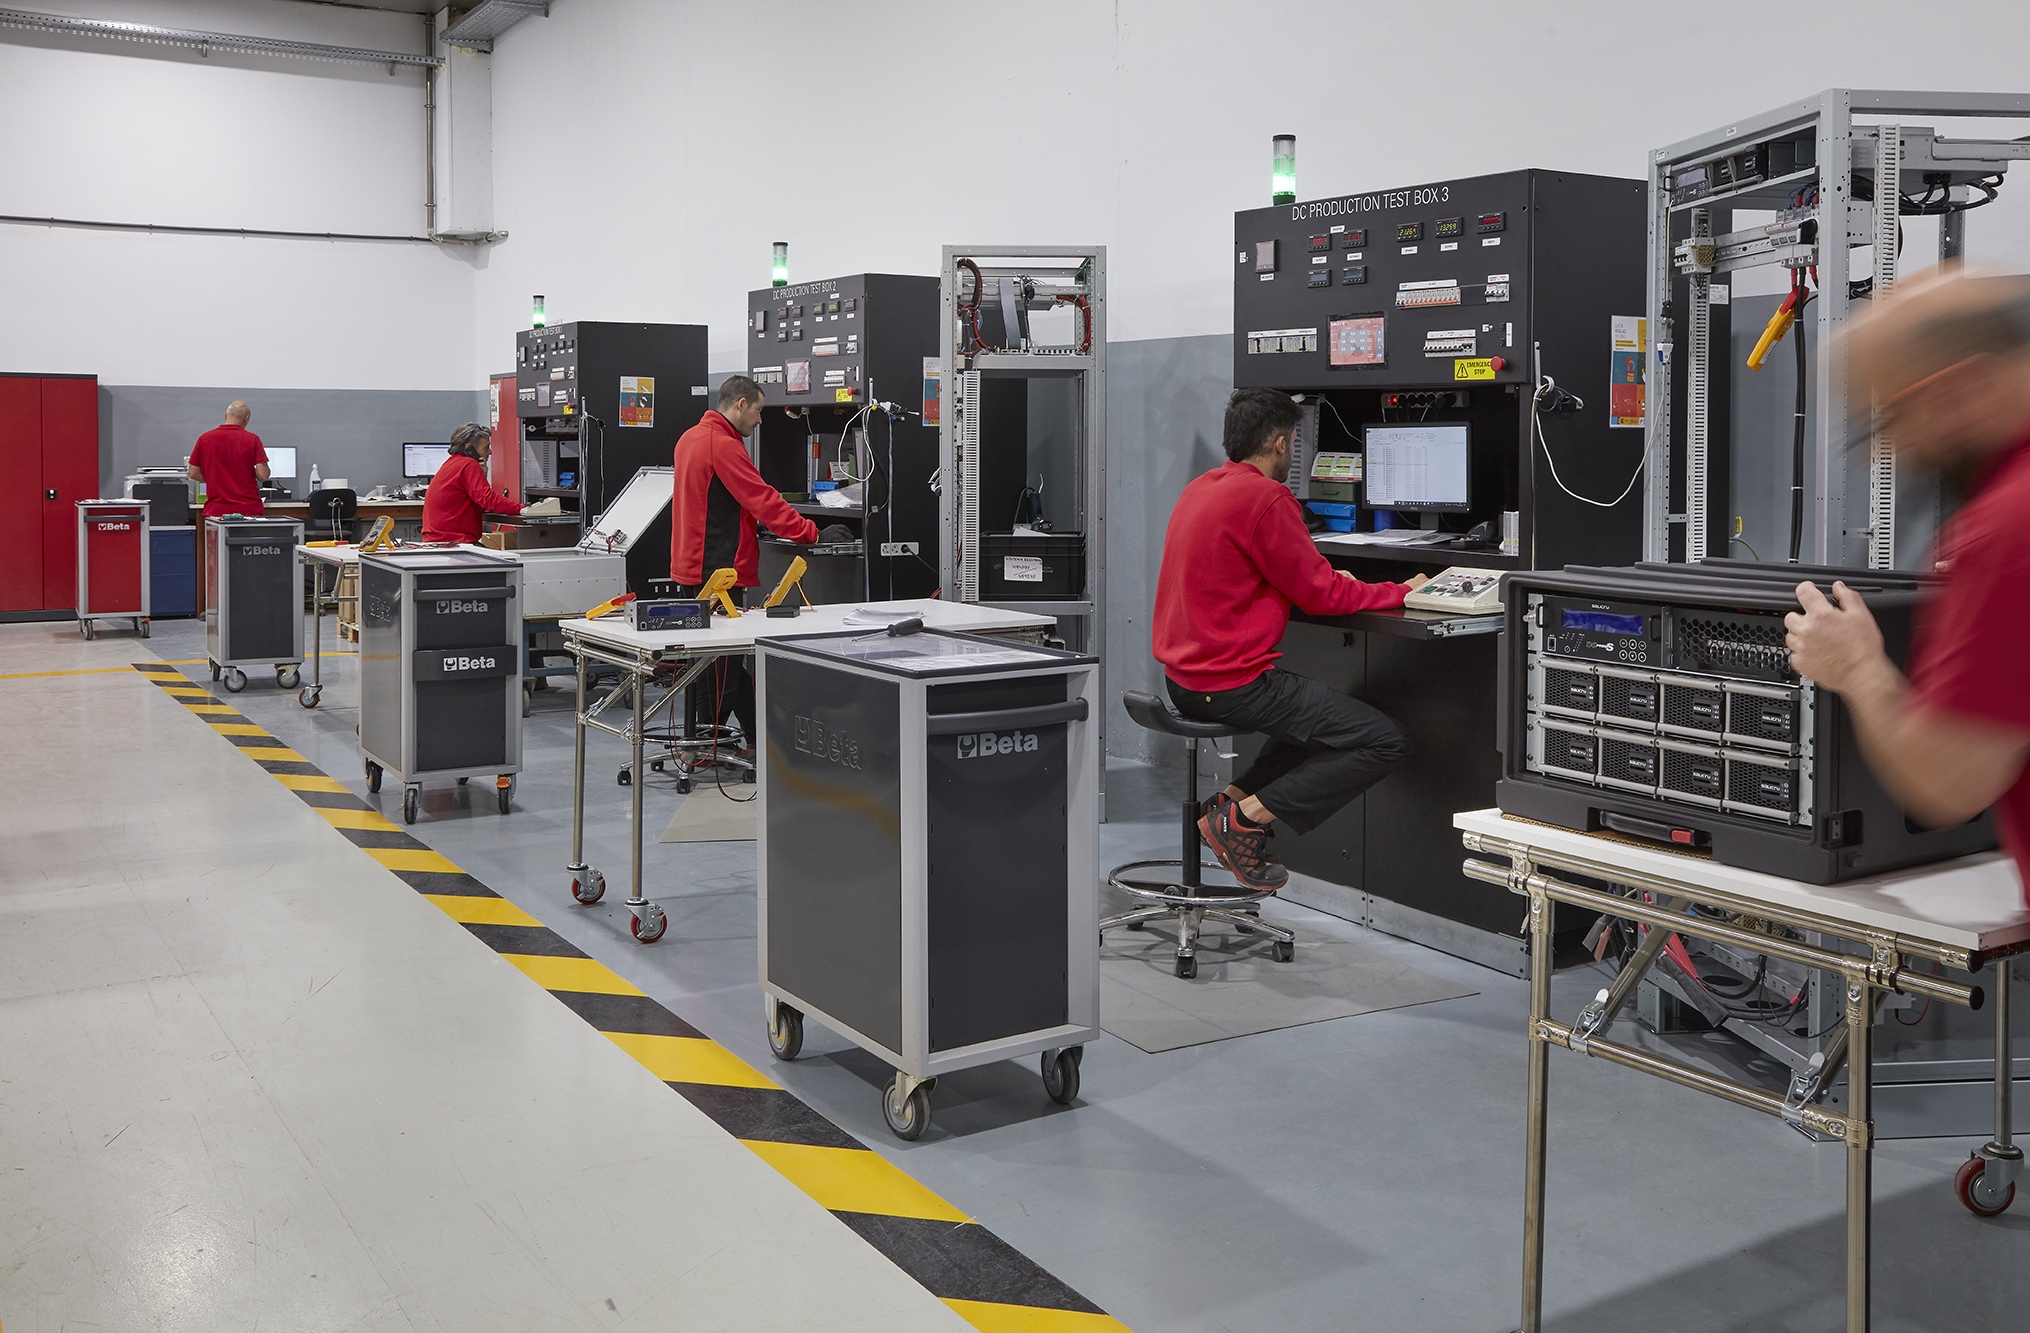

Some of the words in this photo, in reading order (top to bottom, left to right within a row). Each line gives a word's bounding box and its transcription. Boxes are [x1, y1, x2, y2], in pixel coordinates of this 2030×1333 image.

[1292, 205, 1307, 221] DC
[1309, 195, 1380, 218] PRODUCTION
[1383, 190, 1411, 209] TEST
[1414, 187, 1439, 206] BOX
[1441, 186, 1449, 202] 3
[107, 523, 130, 531] Beta
[253, 546, 281, 555] Beta
[451, 600, 488, 613] Beta
[459, 657, 496, 670] Beta
[979, 730, 1038, 757] Beta
